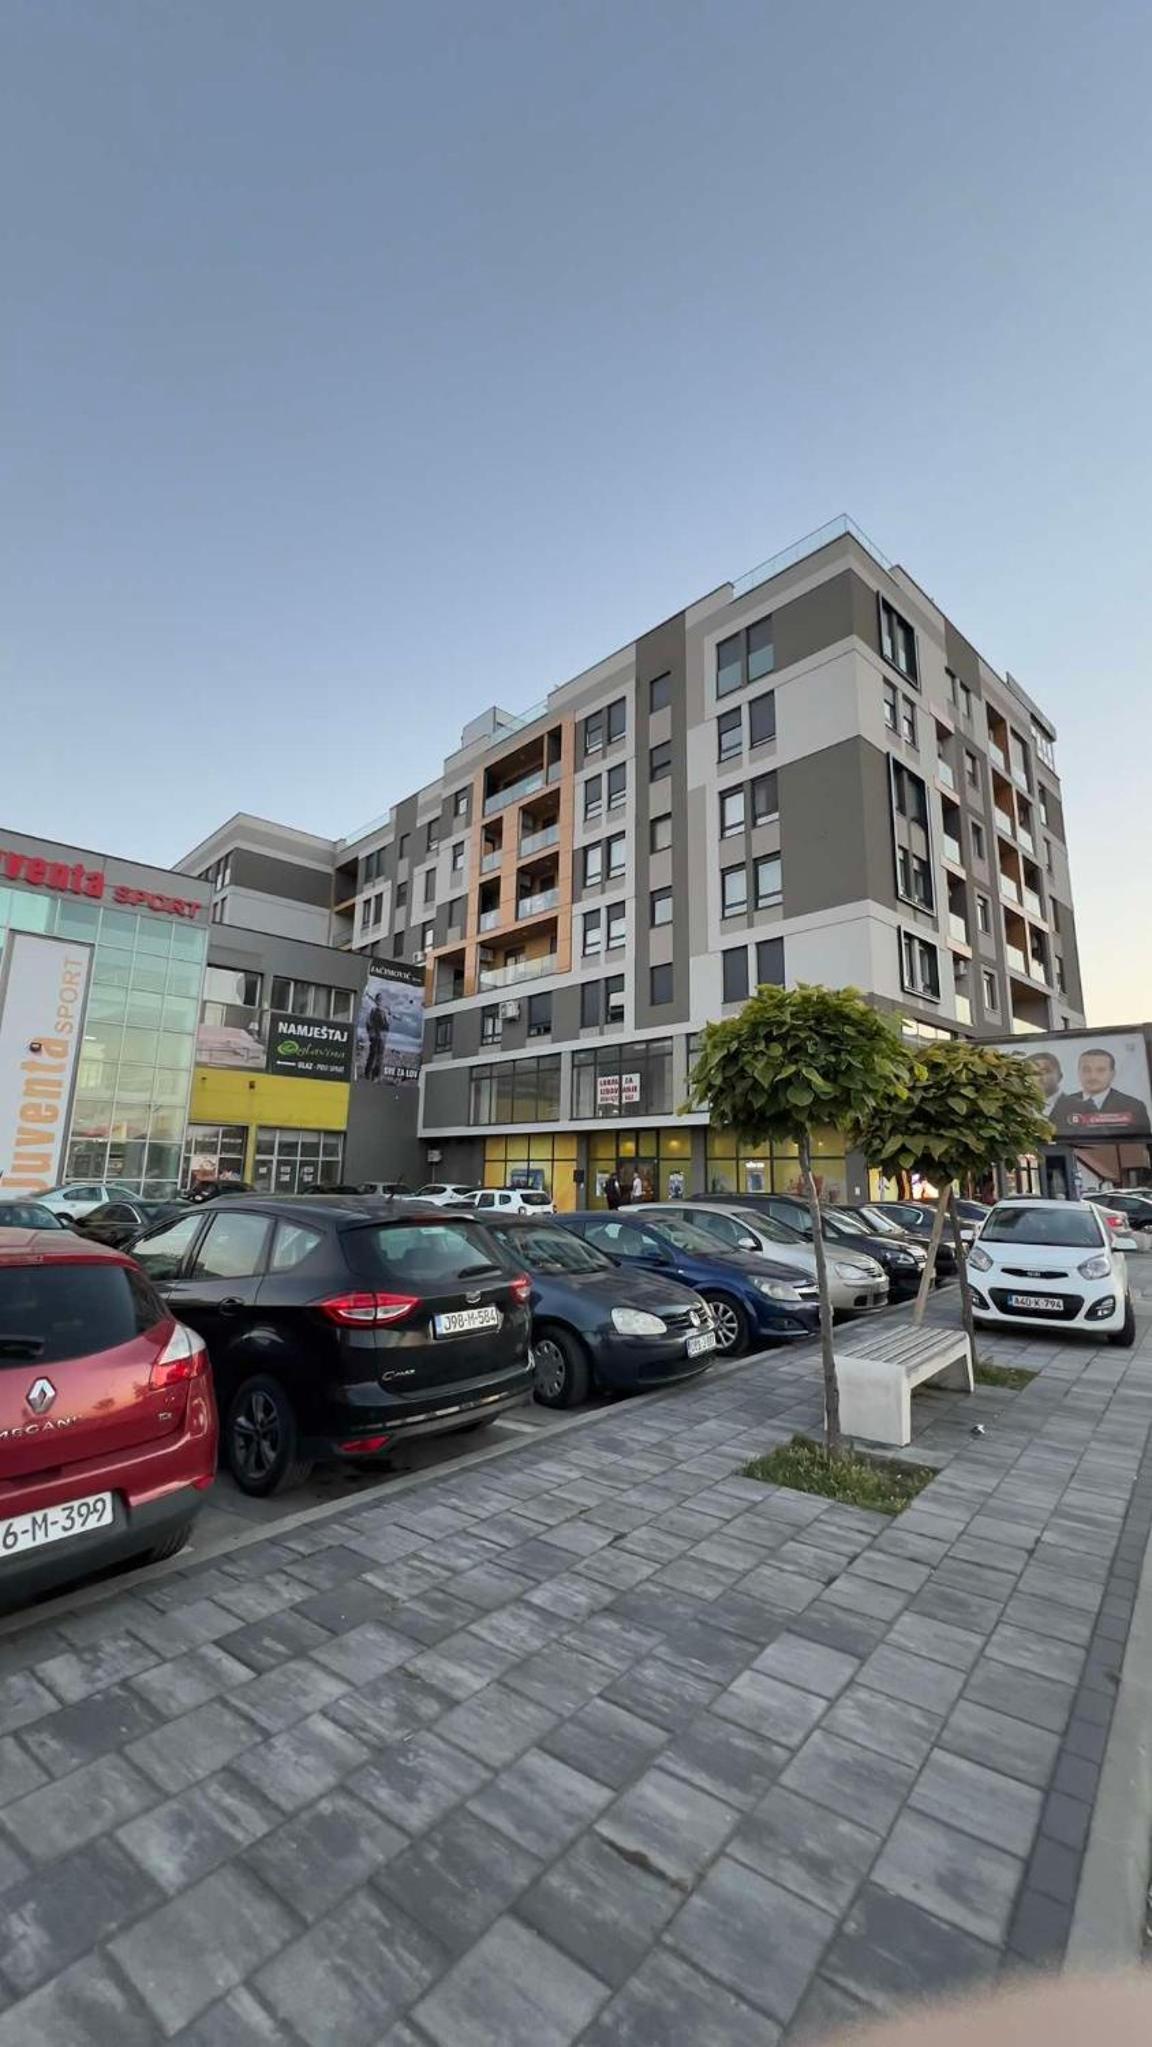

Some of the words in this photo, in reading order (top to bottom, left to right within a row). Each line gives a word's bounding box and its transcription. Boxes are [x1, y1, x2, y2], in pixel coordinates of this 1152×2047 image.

[0, 850, 105, 899] venta
[55, 956, 83, 1035] SPORT
[278, 1021, 349, 1042] NAMJEŠTAJ
